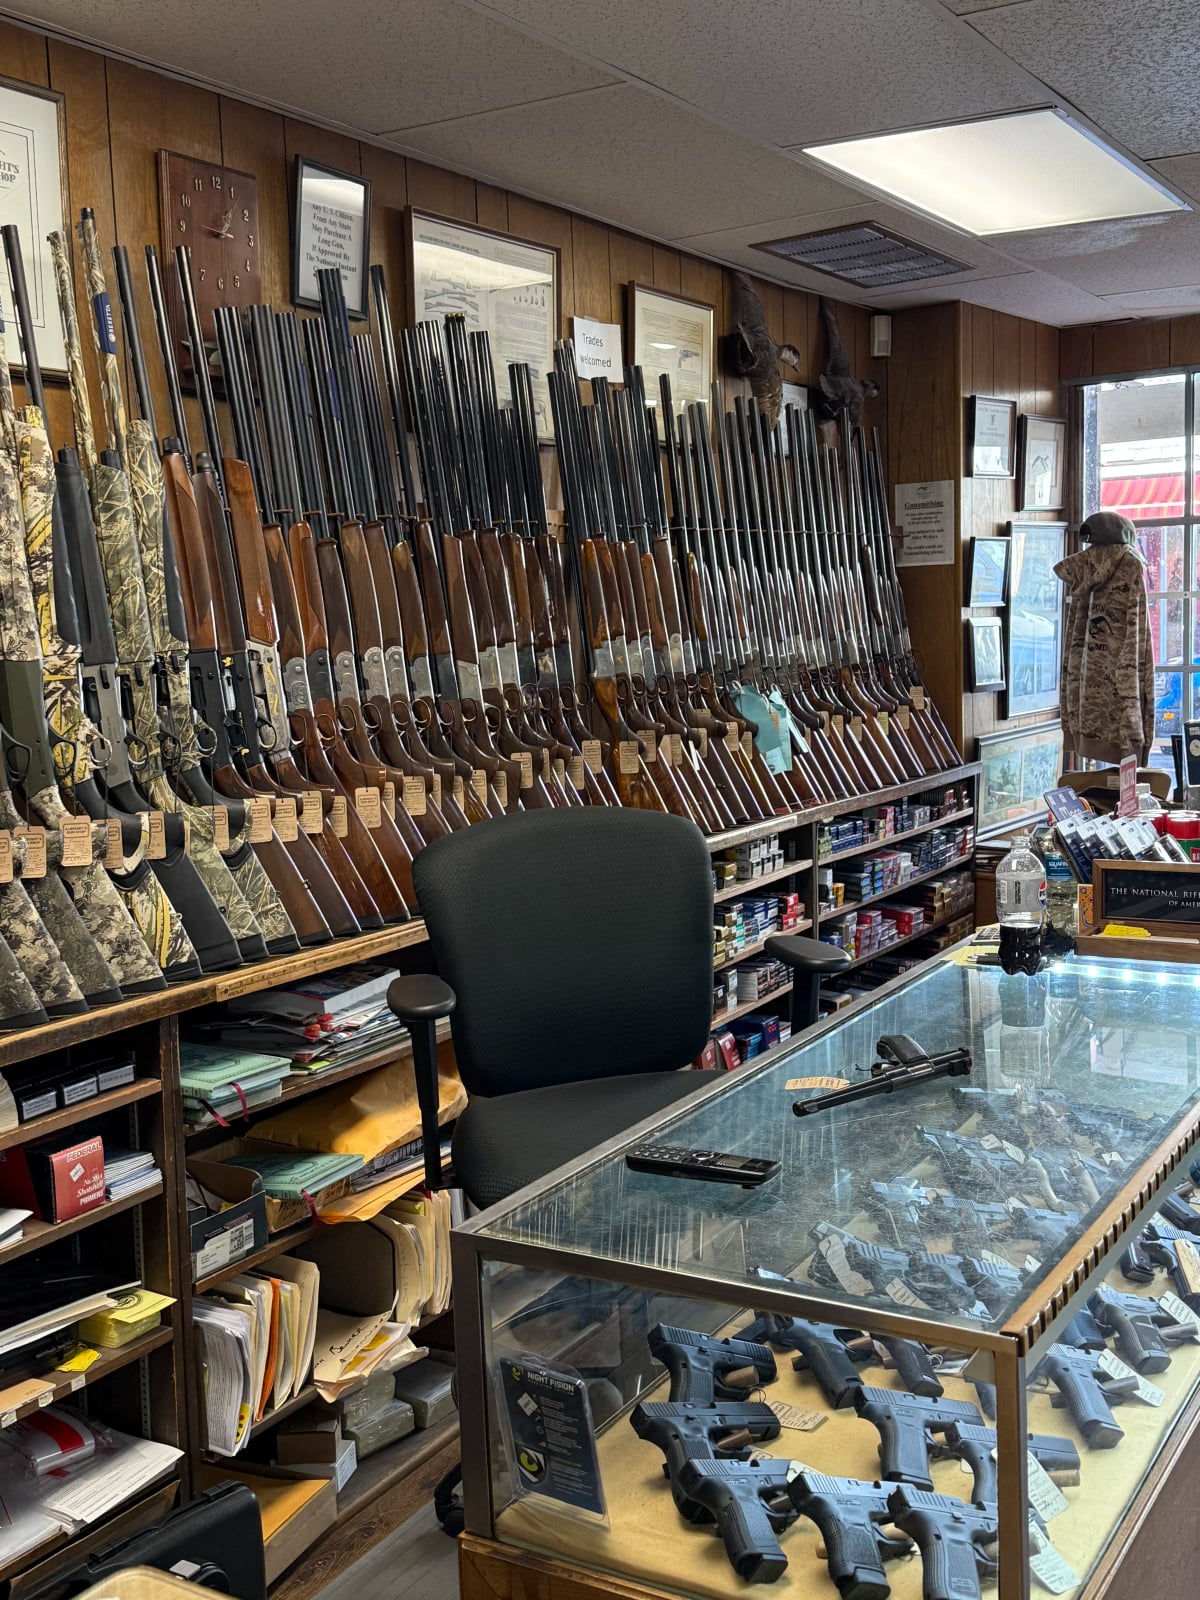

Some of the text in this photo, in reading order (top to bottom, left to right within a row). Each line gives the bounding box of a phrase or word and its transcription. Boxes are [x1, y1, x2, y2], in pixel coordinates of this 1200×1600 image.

[194, 178, 202, 192] 11
[212, 176, 222, 190] 12
[230, 186, 235, 198] 1
[181, 194, 191, 208] 10
[242, 209, 249, 222] 2
[313, 213, 327, 224] From
[338, 222, 352, 232] State
[180, 220, 186, 232] 9
[312, 223, 352, 242] May Purchase A
[248, 235, 254, 248] 3
[318, 236, 331, 248] Long
[318, 246, 342, 259] Approved
[344, 254, 350, 263] By
[245, 260, 251, 273] 4
[306, 252, 357, 273] The National Instant
[200, 268, 206, 281] 7
[218, 278, 224, 290] 6
[234, 276, 240, 288] 5
[582, 332, 604, 346] Trades
[580, 354, 612, 369] welcomed
[1110, 888, 1200, 899] THE NATIONAL RIF
[66, 1141, 102, 1163] FEDERAL
[80, 1189, 104, 1206] PRIMERS
[527, 1371, 575, 1392] NIGHT FISION
